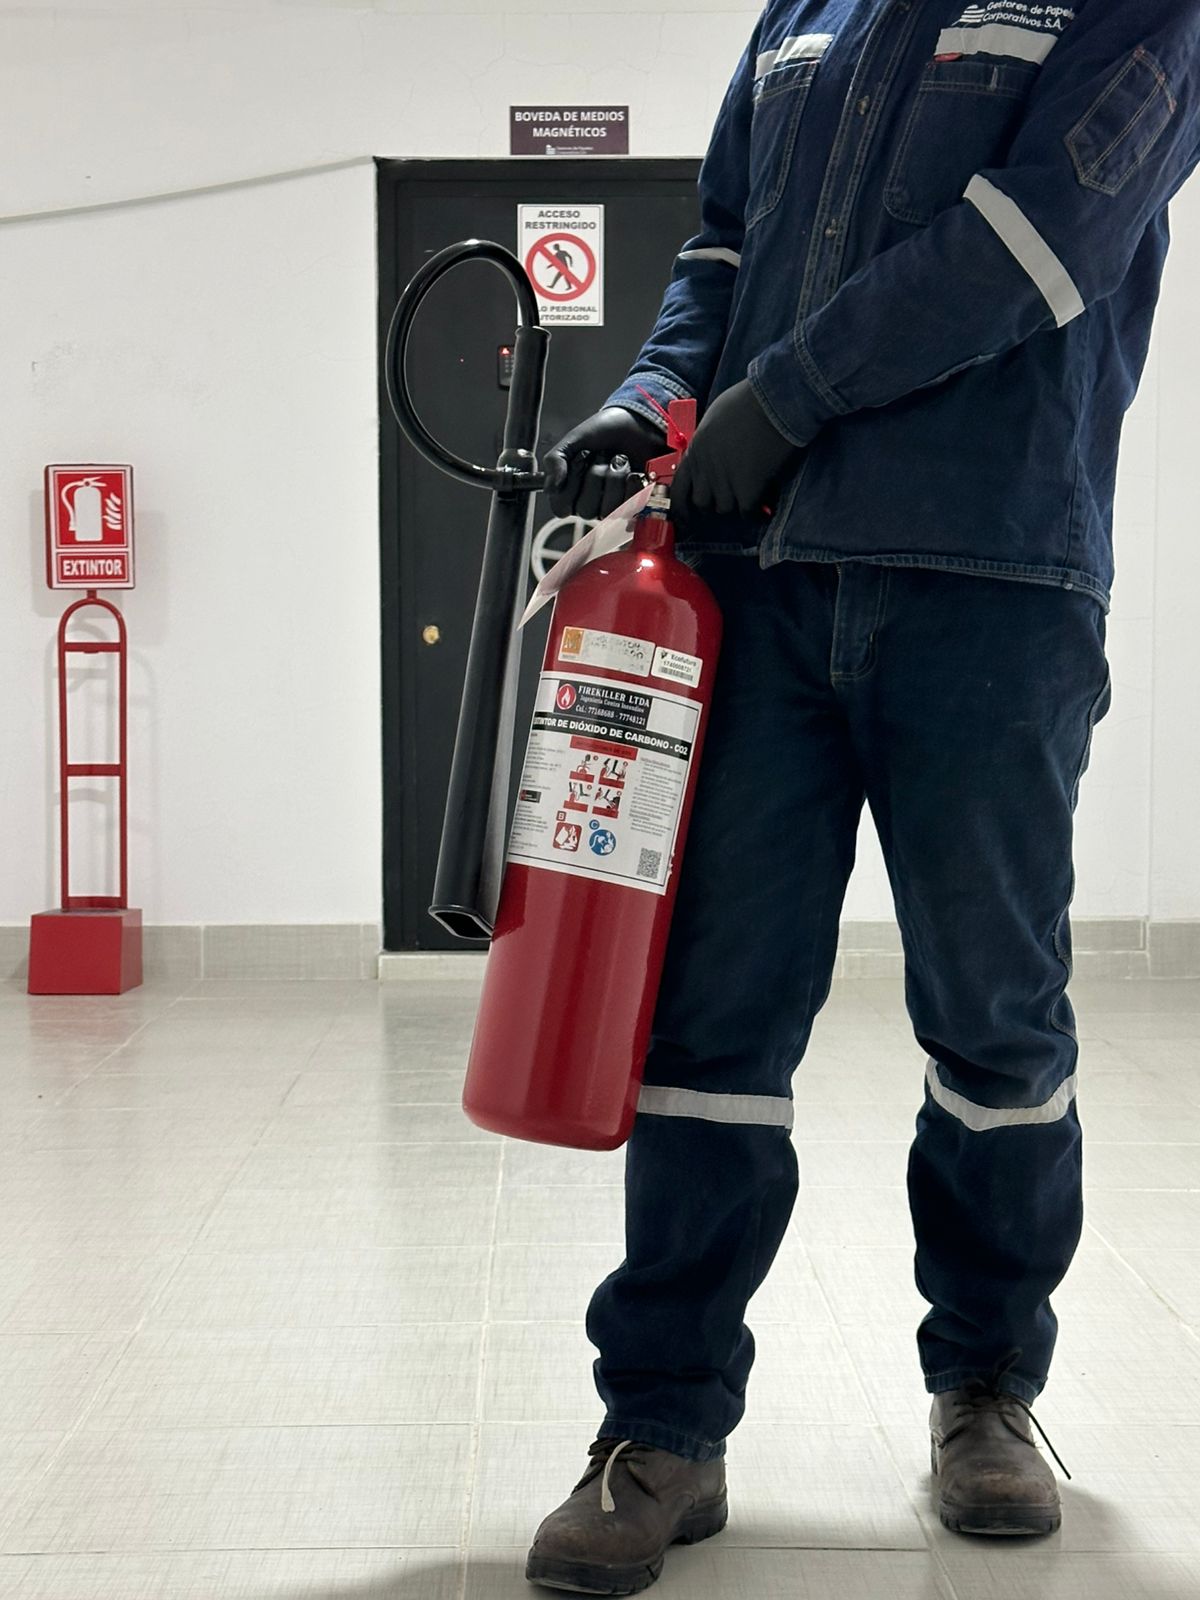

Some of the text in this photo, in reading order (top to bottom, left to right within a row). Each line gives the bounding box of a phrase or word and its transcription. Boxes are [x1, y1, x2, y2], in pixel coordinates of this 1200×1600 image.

[986, 0, 1028, 12] Gestores
[1030, 5, 1043, 15] de
[982, 12, 1042, 28] Corporativos
[514, 111, 625, 121] BOVEDA DE MEDIOS
[532, 125, 607, 138] MAGNÉTICOS
[538, 210, 580, 218] ACCESO
[525, 221, 597, 230] RESTRINGIDO
[62, 559, 123, 576] EXTINTOR
[578, 685, 650, 708] FIREKILLER LTDA
[557, 719, 569, 728] DE
[569, 721, 608, 735] DIÓXIDO
[609, 728, 624, 738] DE
[624, 731, 670, 749] CARBONO
